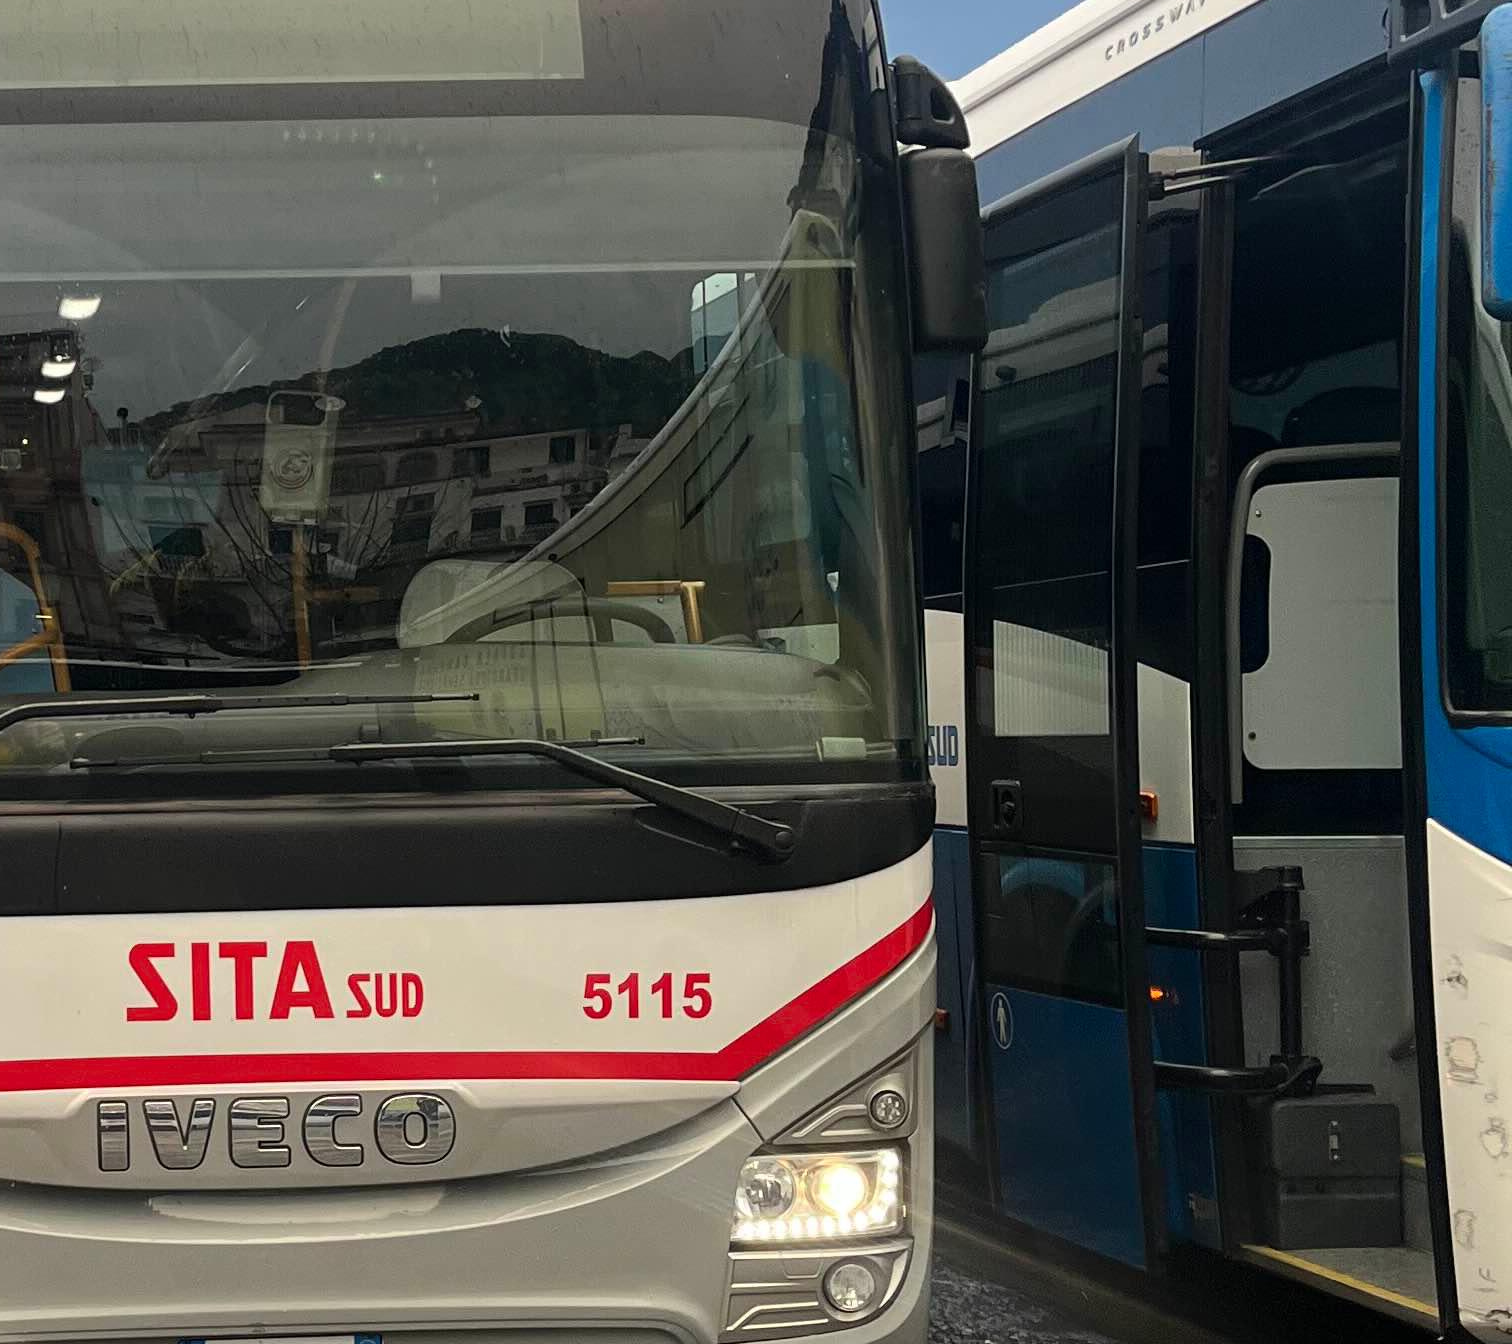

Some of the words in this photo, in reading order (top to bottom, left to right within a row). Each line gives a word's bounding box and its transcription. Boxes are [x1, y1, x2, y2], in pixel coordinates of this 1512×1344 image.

[126, 941, 335, 1022] SITA
[346, 973, 424, 1018] SUD
[583, 973, 713, 1019] 5115
[97, 1092, 456, 1172] IVECO
